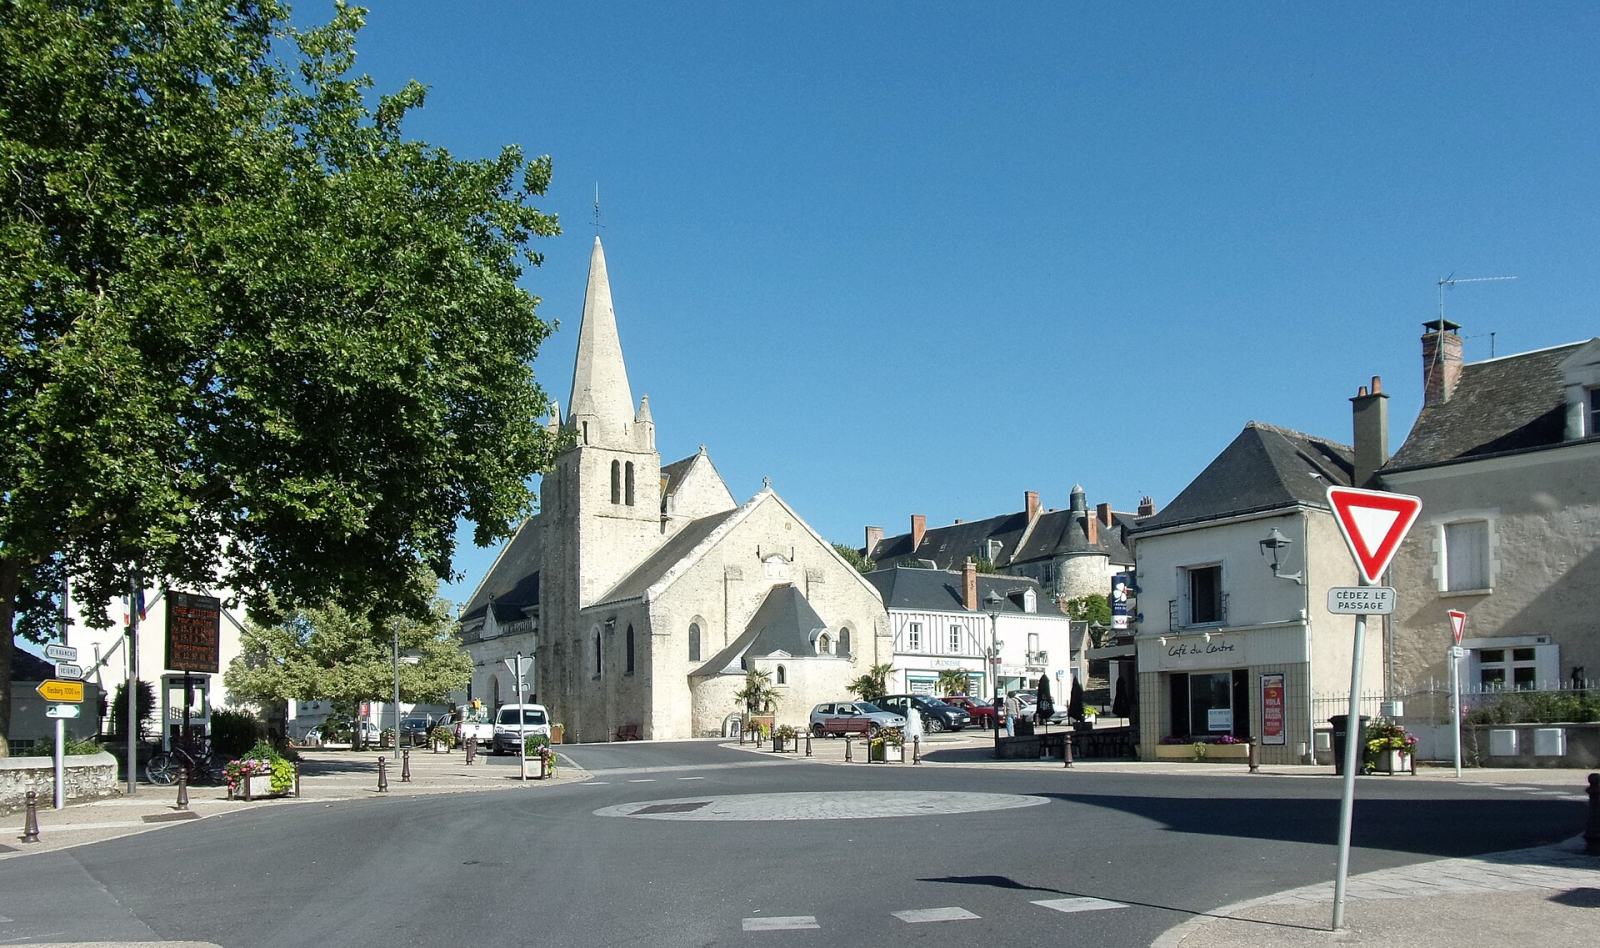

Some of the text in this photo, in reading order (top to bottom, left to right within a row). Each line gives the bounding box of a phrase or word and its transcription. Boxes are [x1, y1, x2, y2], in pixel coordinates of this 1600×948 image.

[1336, 590, 1387, 600] CÉDEZ LE
[1338, 601, 1384, 610] PASSAGE
[1168, 641, 1235, 657] Café du Centre
